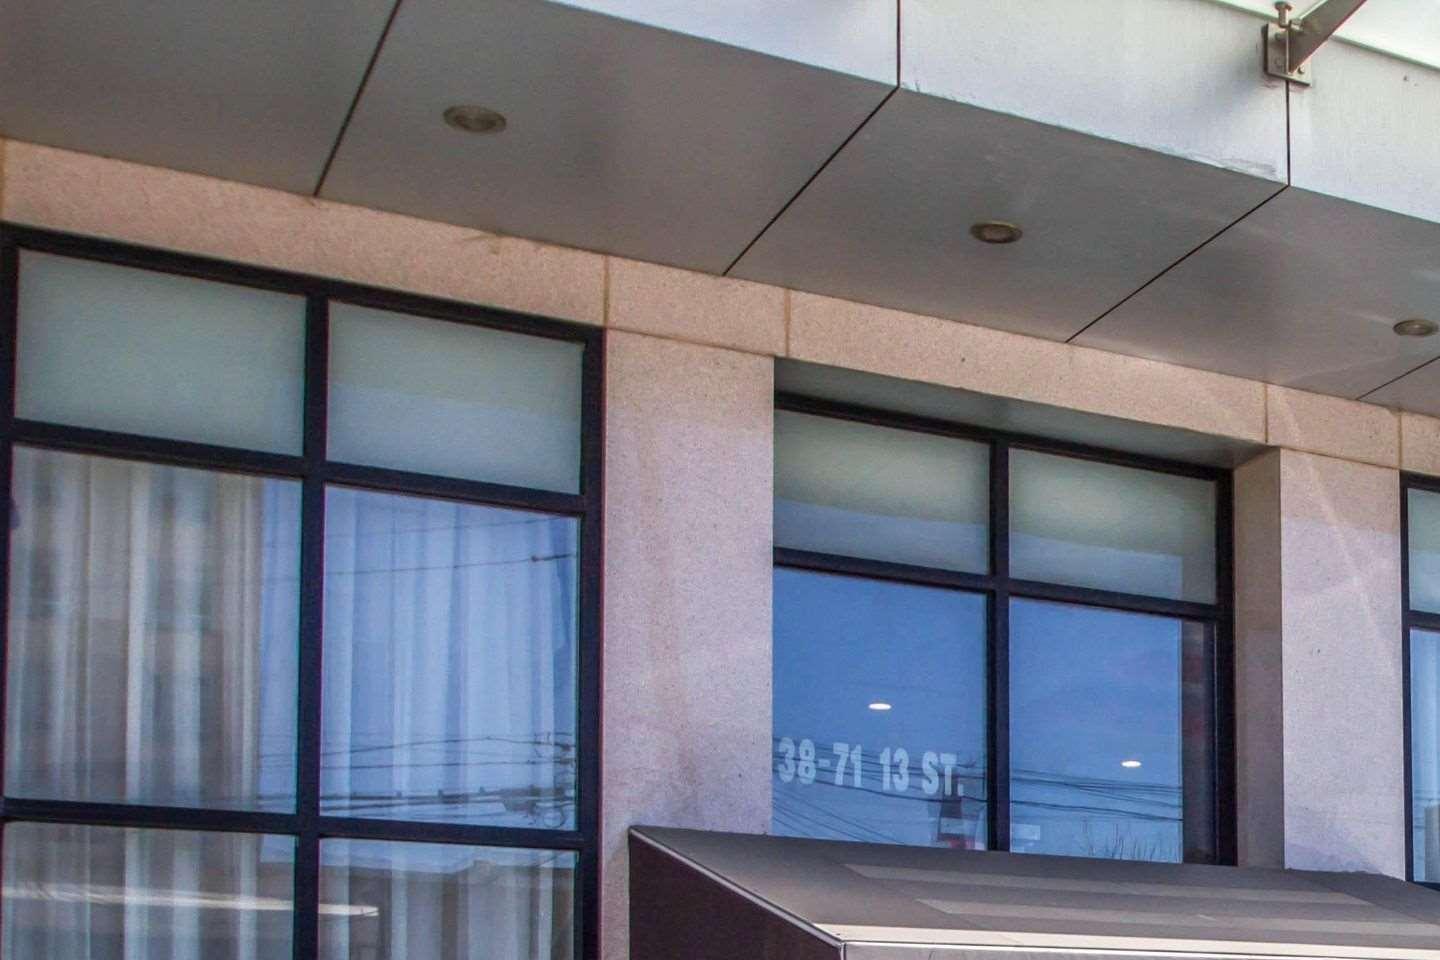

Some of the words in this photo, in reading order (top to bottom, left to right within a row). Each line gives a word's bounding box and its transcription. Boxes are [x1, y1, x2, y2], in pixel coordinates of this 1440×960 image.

[777, 736, 863, 789] 38-71
[880, 746, 910, 793] 13
[921, 750, 964, 796] ST.
